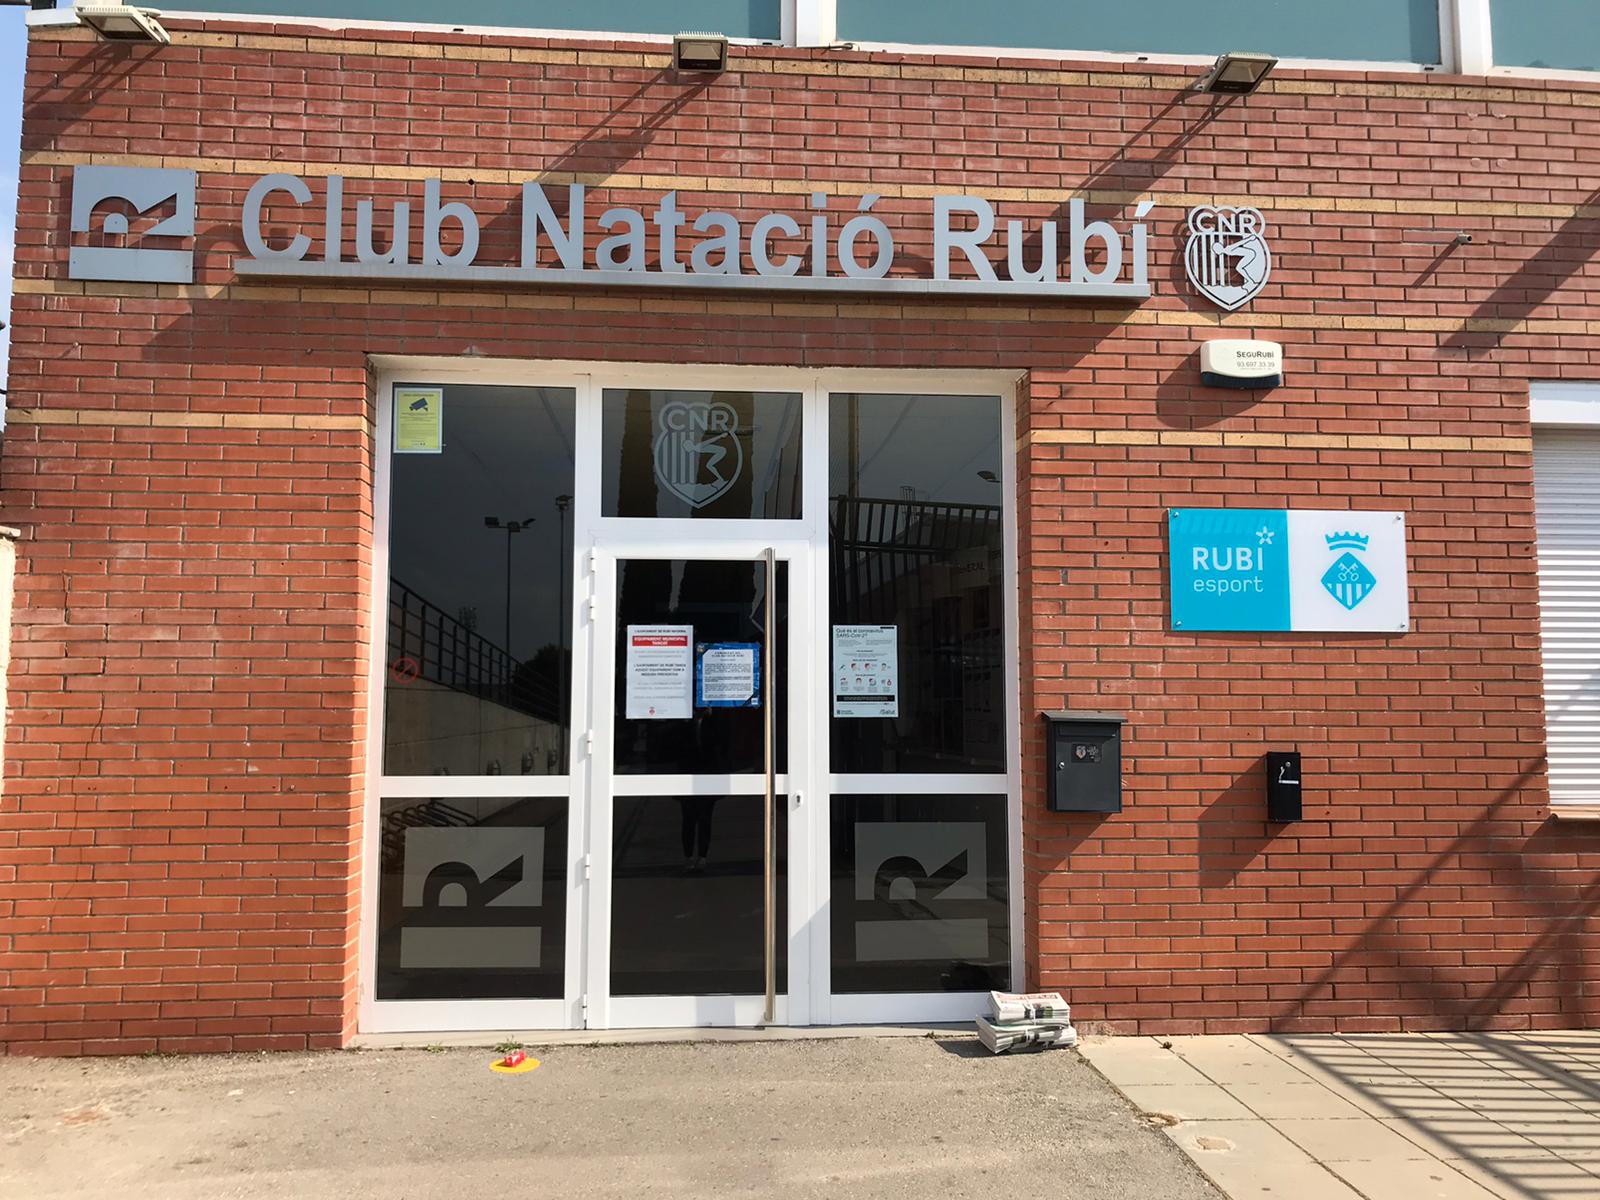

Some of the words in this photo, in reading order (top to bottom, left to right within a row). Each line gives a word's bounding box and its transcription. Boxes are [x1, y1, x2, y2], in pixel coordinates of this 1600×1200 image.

[241, 173, 480, 266] Club
[521, 181, 895, 279] Natació
[932, 194, 1156, 286] Rubí
[1196, 213, 1257, 233] CNR
[667, 409, 730, 431] CNR
[1193, 575, 1264, 596] esport
